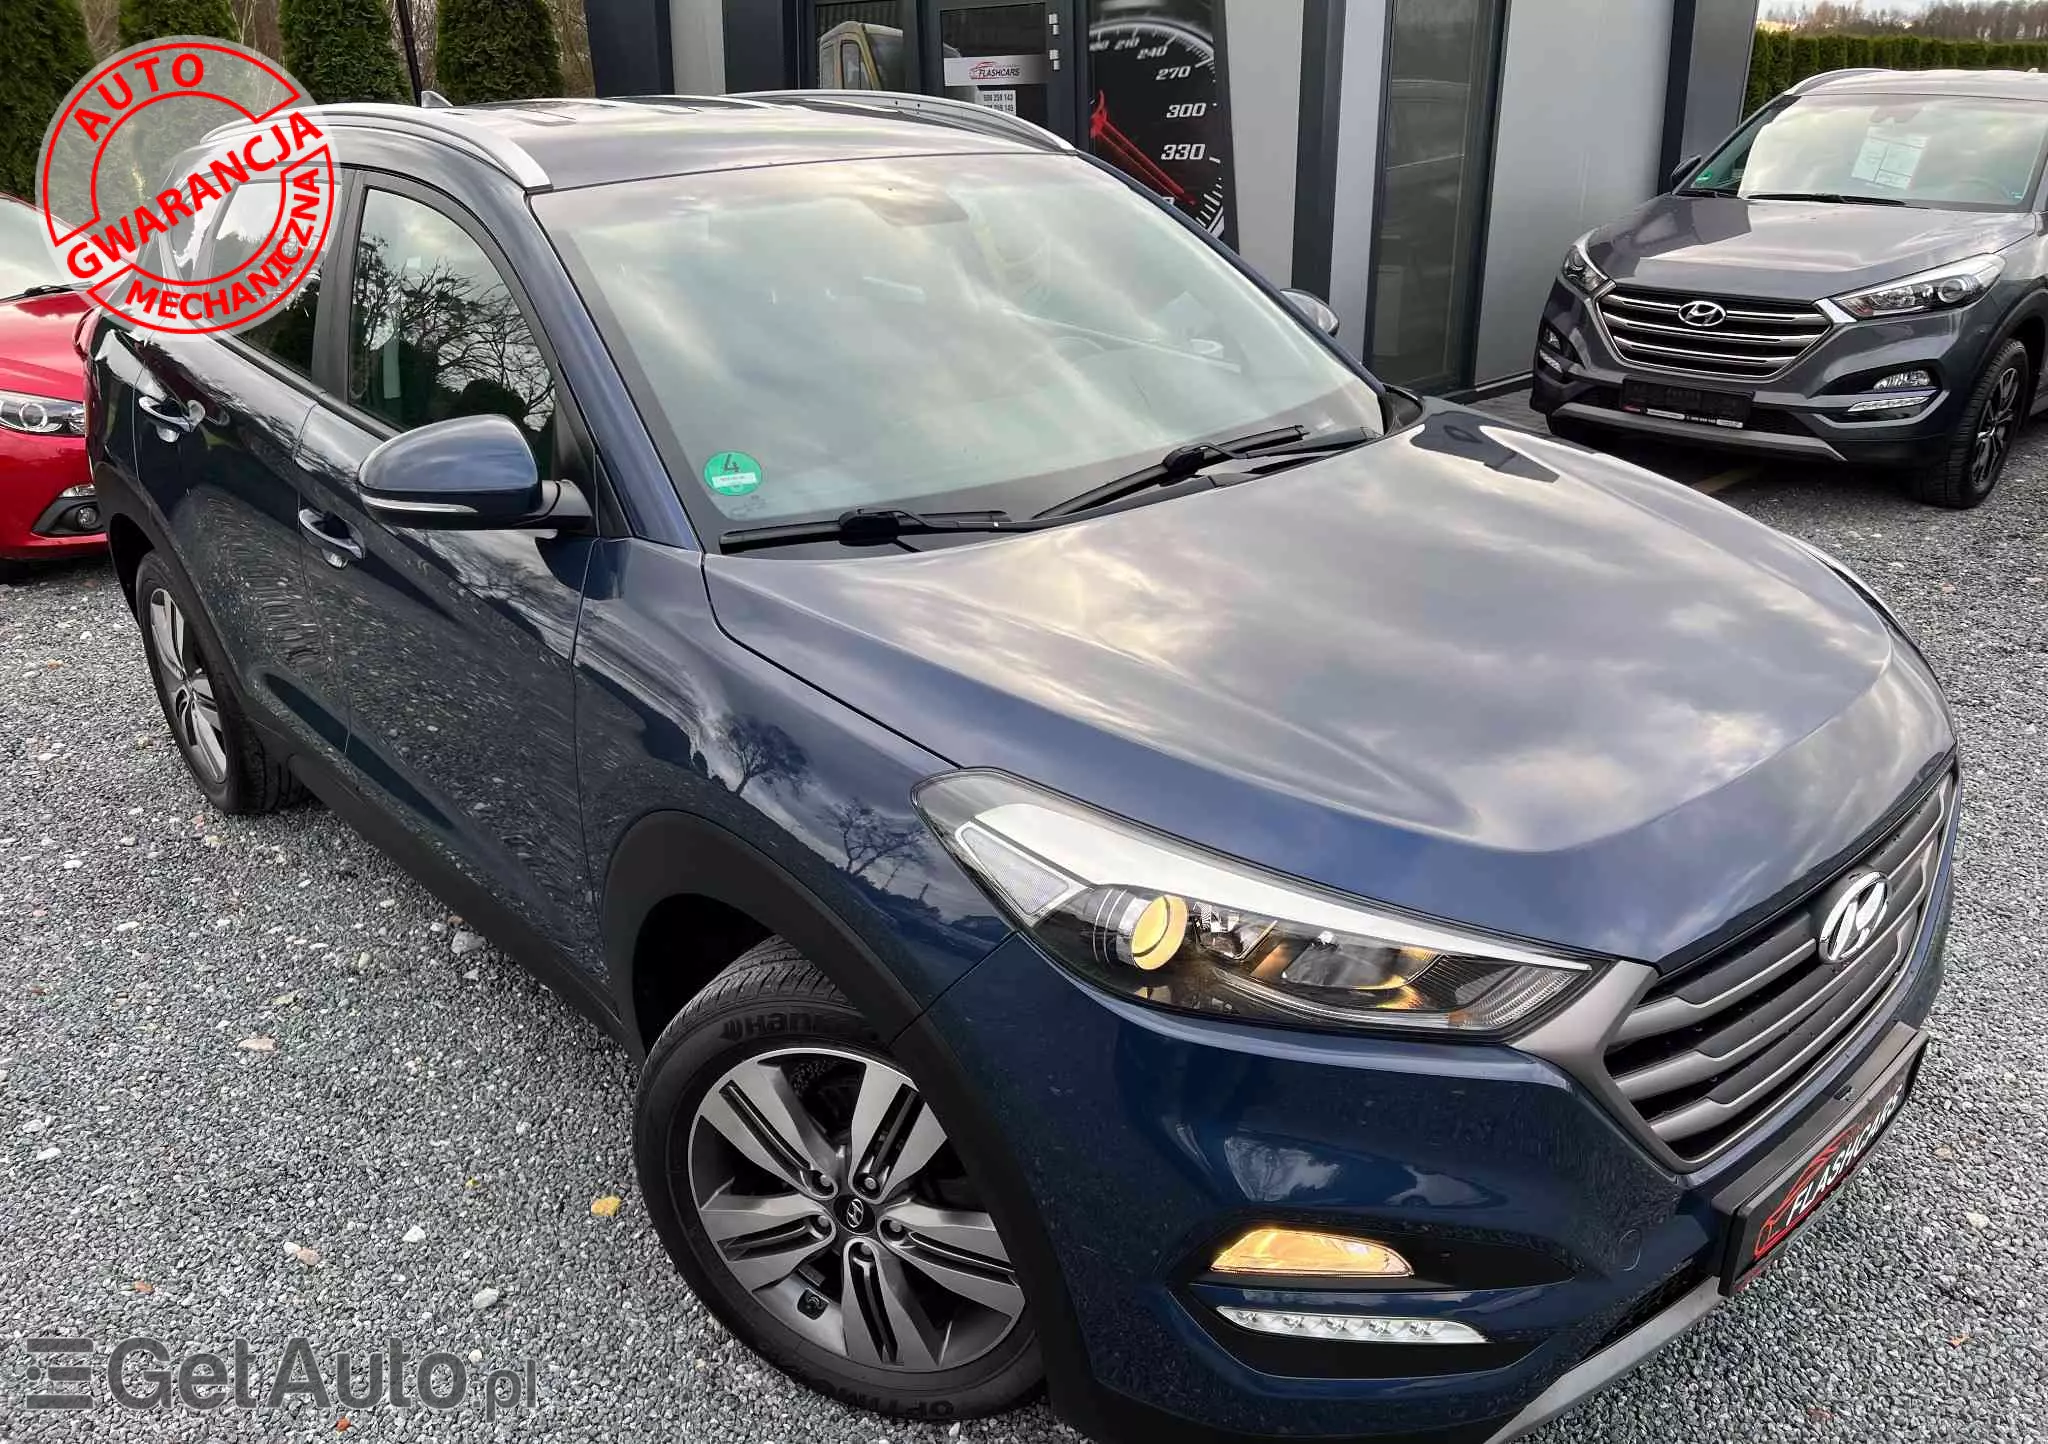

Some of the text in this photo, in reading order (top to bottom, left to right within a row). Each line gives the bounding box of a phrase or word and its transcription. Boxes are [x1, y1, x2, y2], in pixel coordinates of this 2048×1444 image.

[1136, 45, 1168, 60] 240
[978, 67, 1021, 78] FLASHCARS
[1155, 65, 1192, 81] 270
[1166, 102, 1207, 118] 300
[1160, 143, 1206, 161] 330
[723, 453, 740, 473] 4
[1786, 1084, 1904, 1227] FLASHCARS
